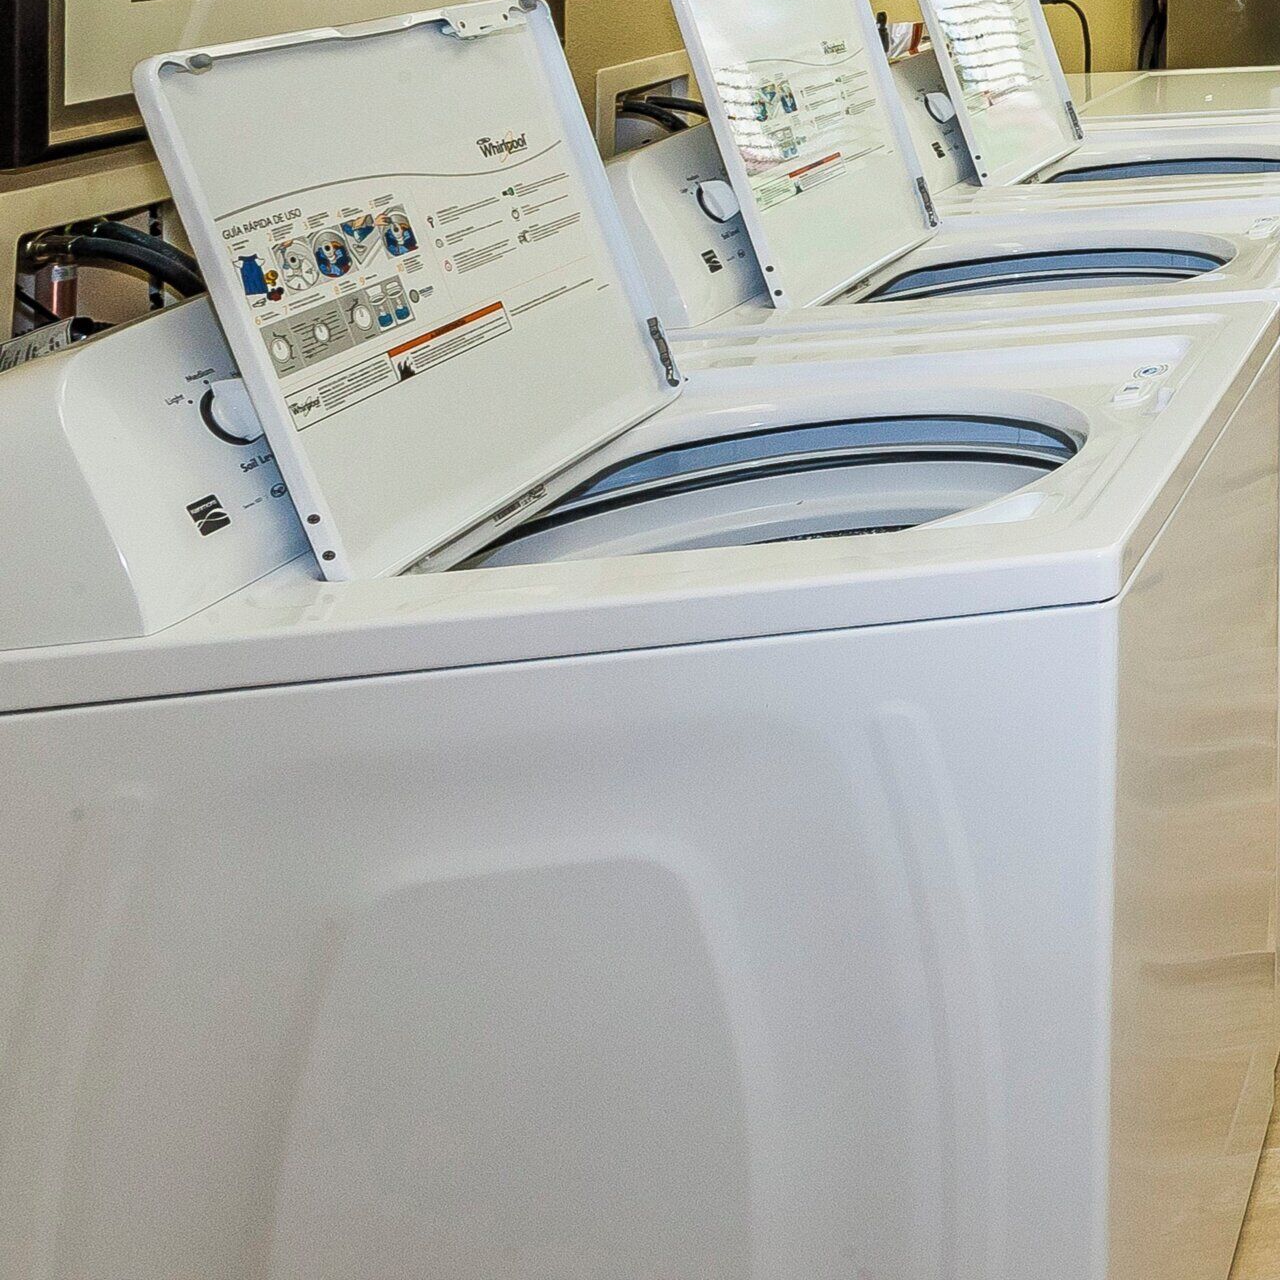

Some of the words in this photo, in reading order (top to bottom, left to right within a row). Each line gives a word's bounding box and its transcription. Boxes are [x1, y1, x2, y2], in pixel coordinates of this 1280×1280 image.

[478, 132, 528, 158] Whirlpool
[272, 212, 285, 225] DE
[284, 208, 302, 221] USO
[239, 457, 259, 473] Soil
